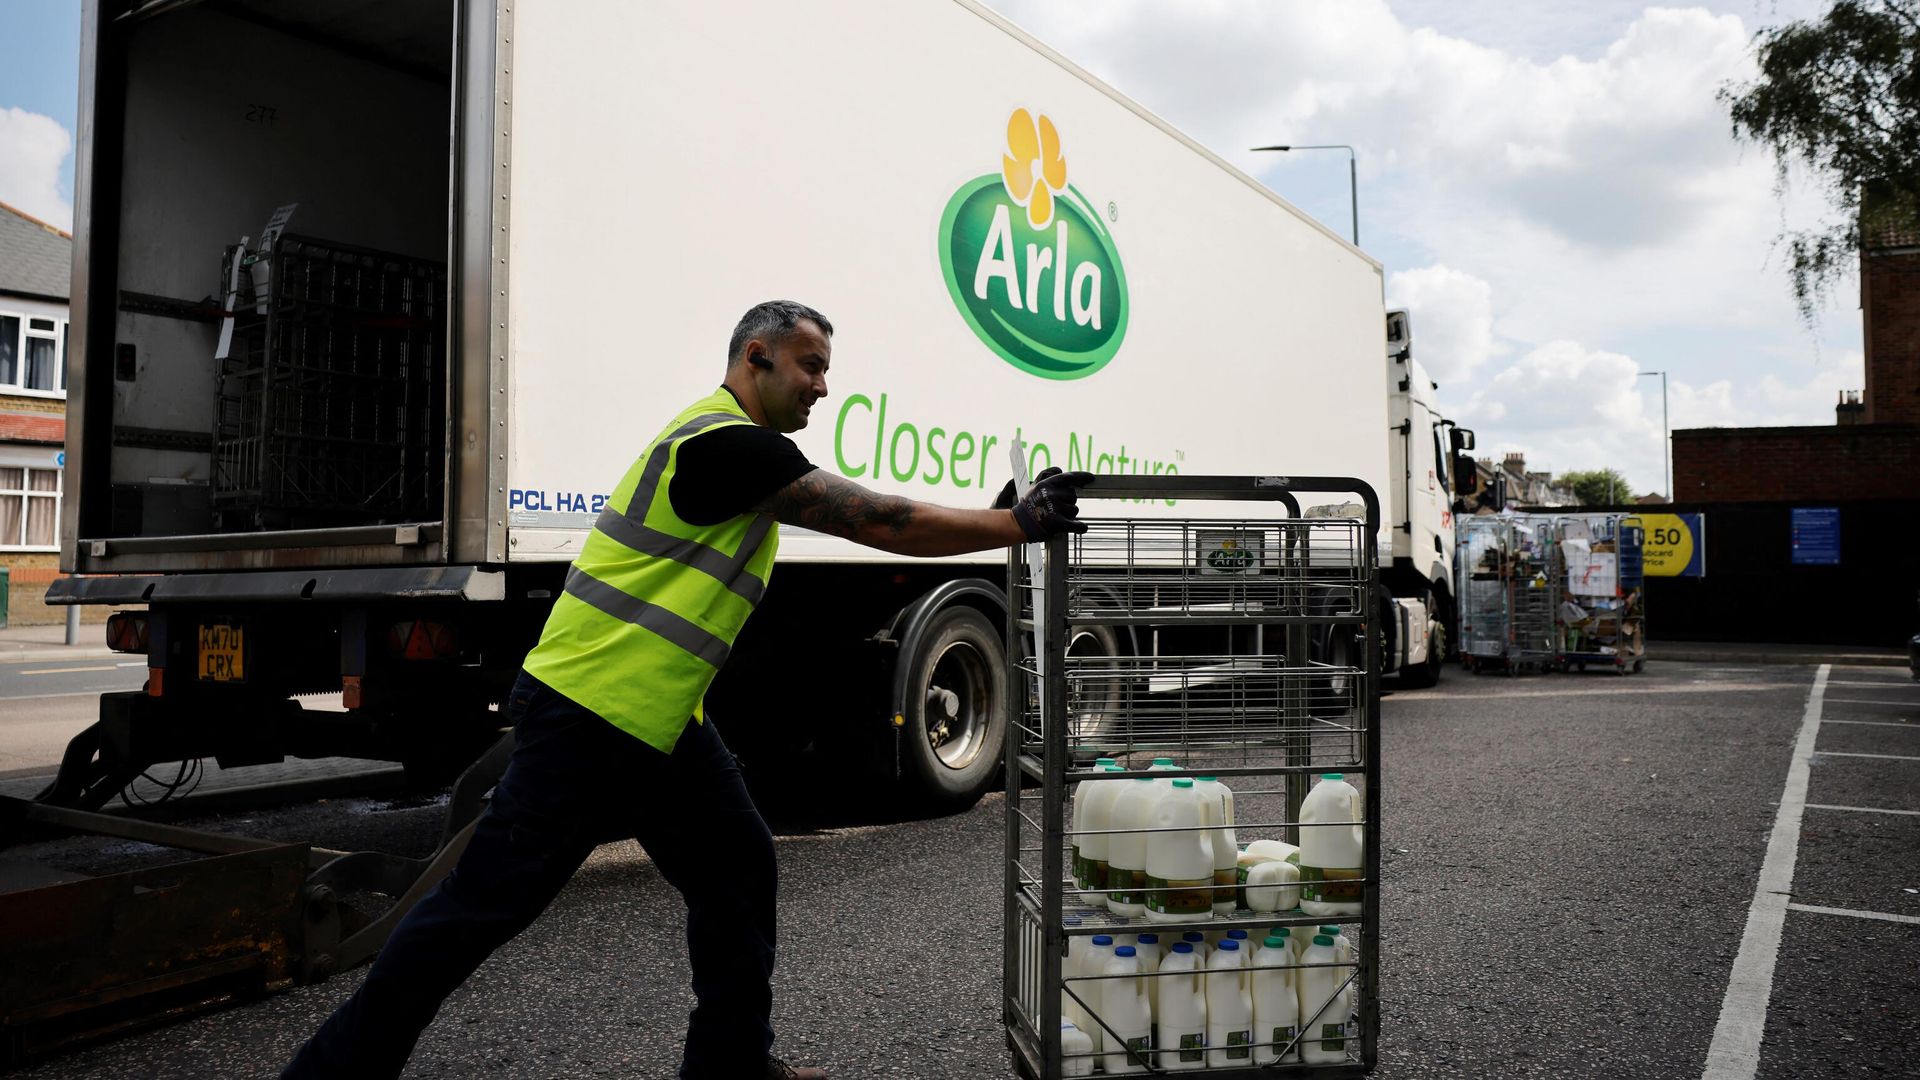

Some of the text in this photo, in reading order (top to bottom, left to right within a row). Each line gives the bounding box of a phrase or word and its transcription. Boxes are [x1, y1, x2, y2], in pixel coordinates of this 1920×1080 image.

[973, 203, 1102, 331] Arla
[834, 392, 998, 490] Closer
[509, 489, 611, 513] PCL HA 2
[1641, 528, 1681, 545] .50
[1643, 549, 1673, 557] ubcard
